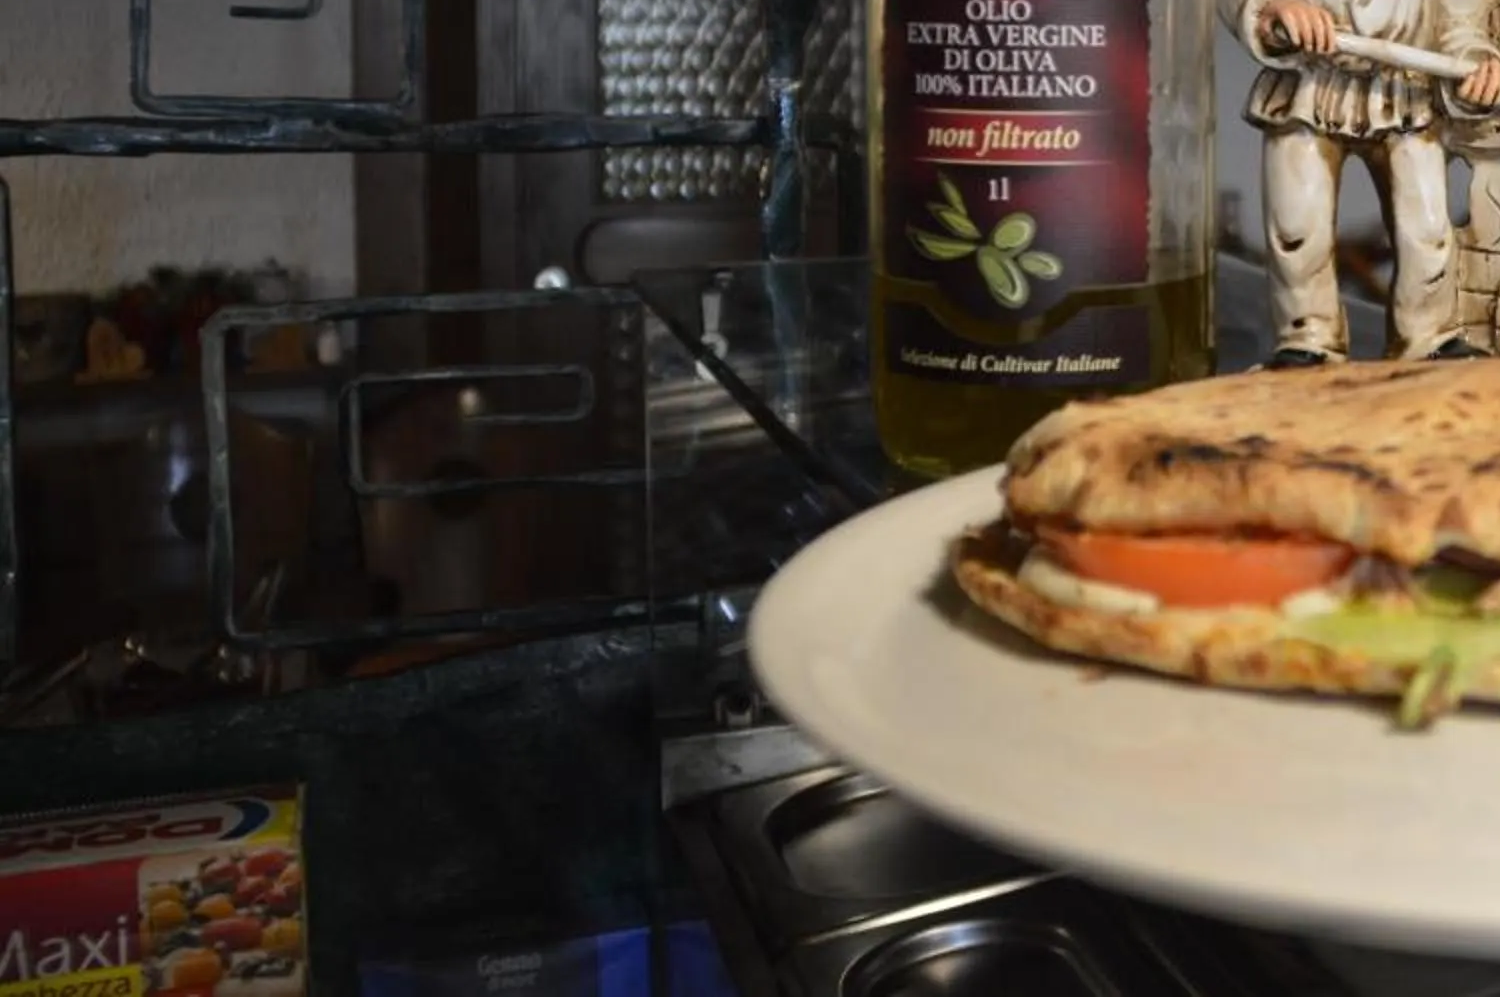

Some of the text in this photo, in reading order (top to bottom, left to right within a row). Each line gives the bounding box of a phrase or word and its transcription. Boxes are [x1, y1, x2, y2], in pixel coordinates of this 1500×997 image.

[965, 0, 1032, 22] OLIO
[907, 22, 1106, 47] EXTRA VERGINE
[944, 49, 1056, 72] DI OLIVA
[915, 74, 1096, 98] 100% ITALIANO
[927, 120, 1081, 156] non filtrato
[960, 353, 977, 371] di
[980, 355, 1051, 373] Cultivar
[1055, 353, 1121, 373] Italiane
